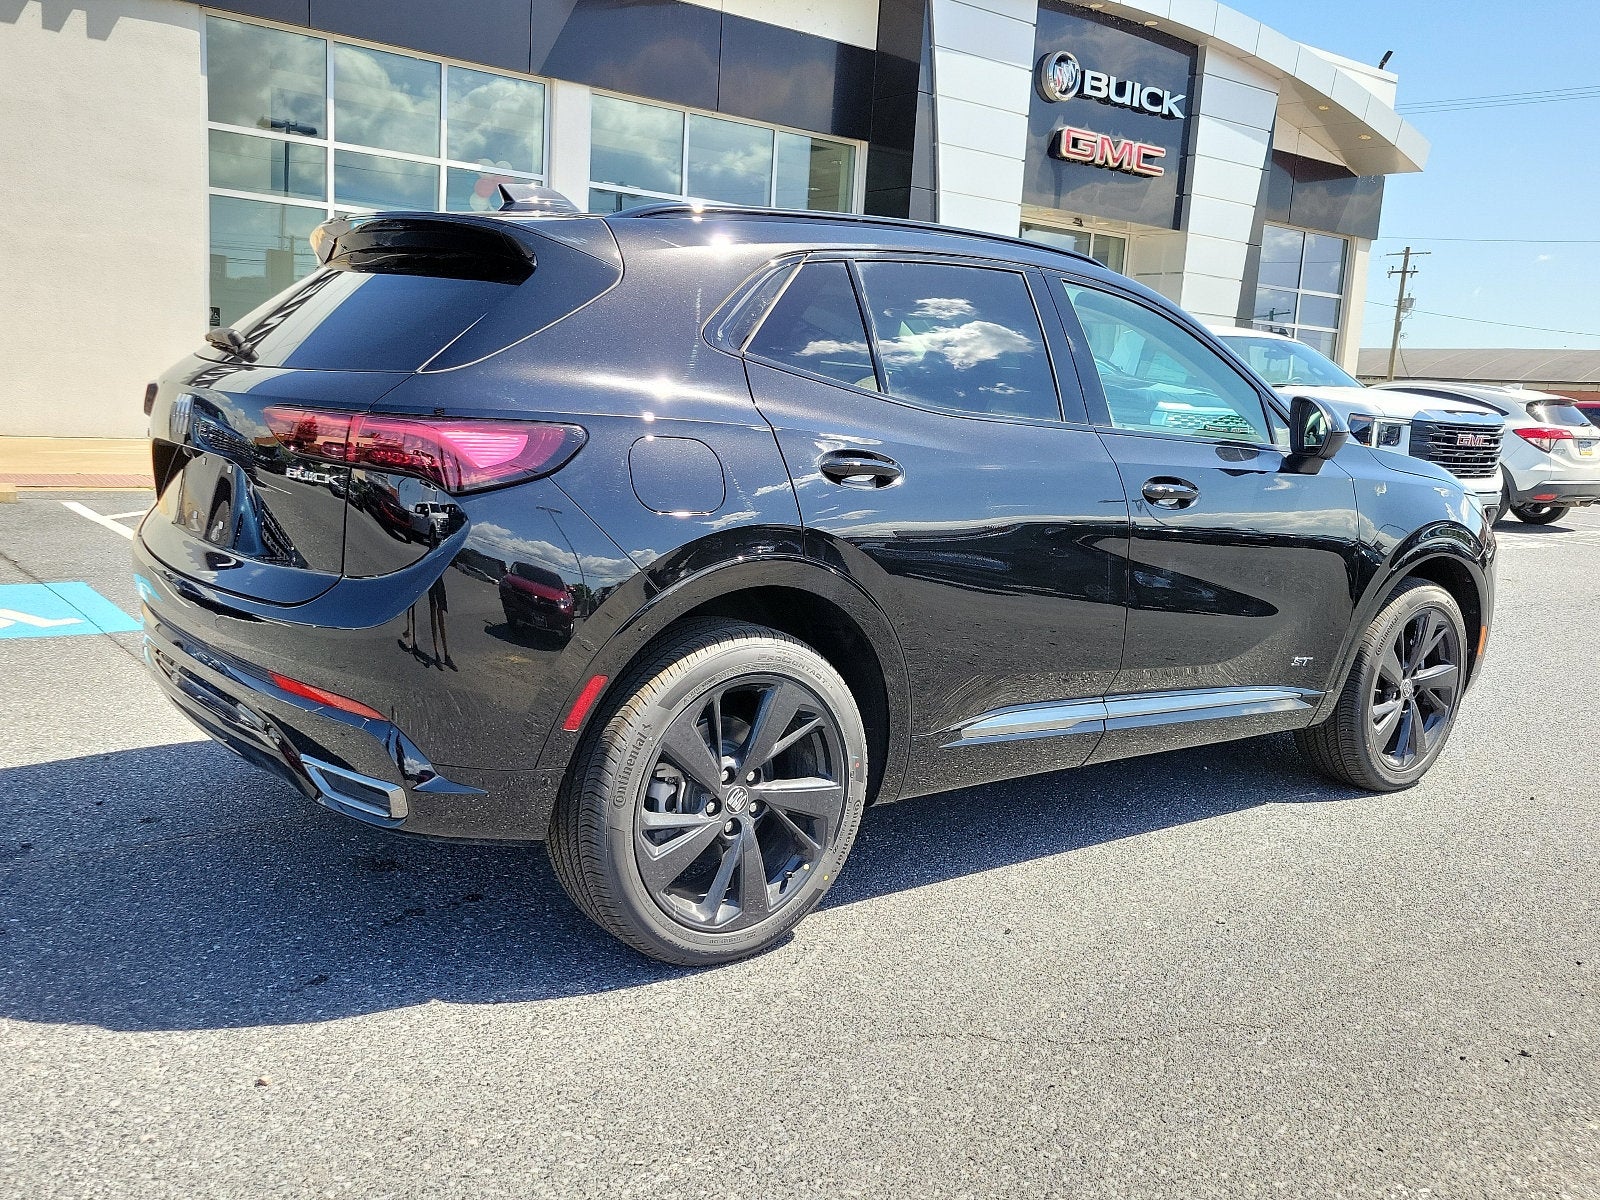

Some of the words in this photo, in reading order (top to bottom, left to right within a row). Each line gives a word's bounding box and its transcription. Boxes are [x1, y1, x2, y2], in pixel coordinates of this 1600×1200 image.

[1083, 69, 1187, 119] BUICK
[1060, 126, 1166, 177] GMC
[1457, 434, 1491, 447] GMC
[286, 467, 346, 489] BUICK
[613, 731, 647, 810] Continental
